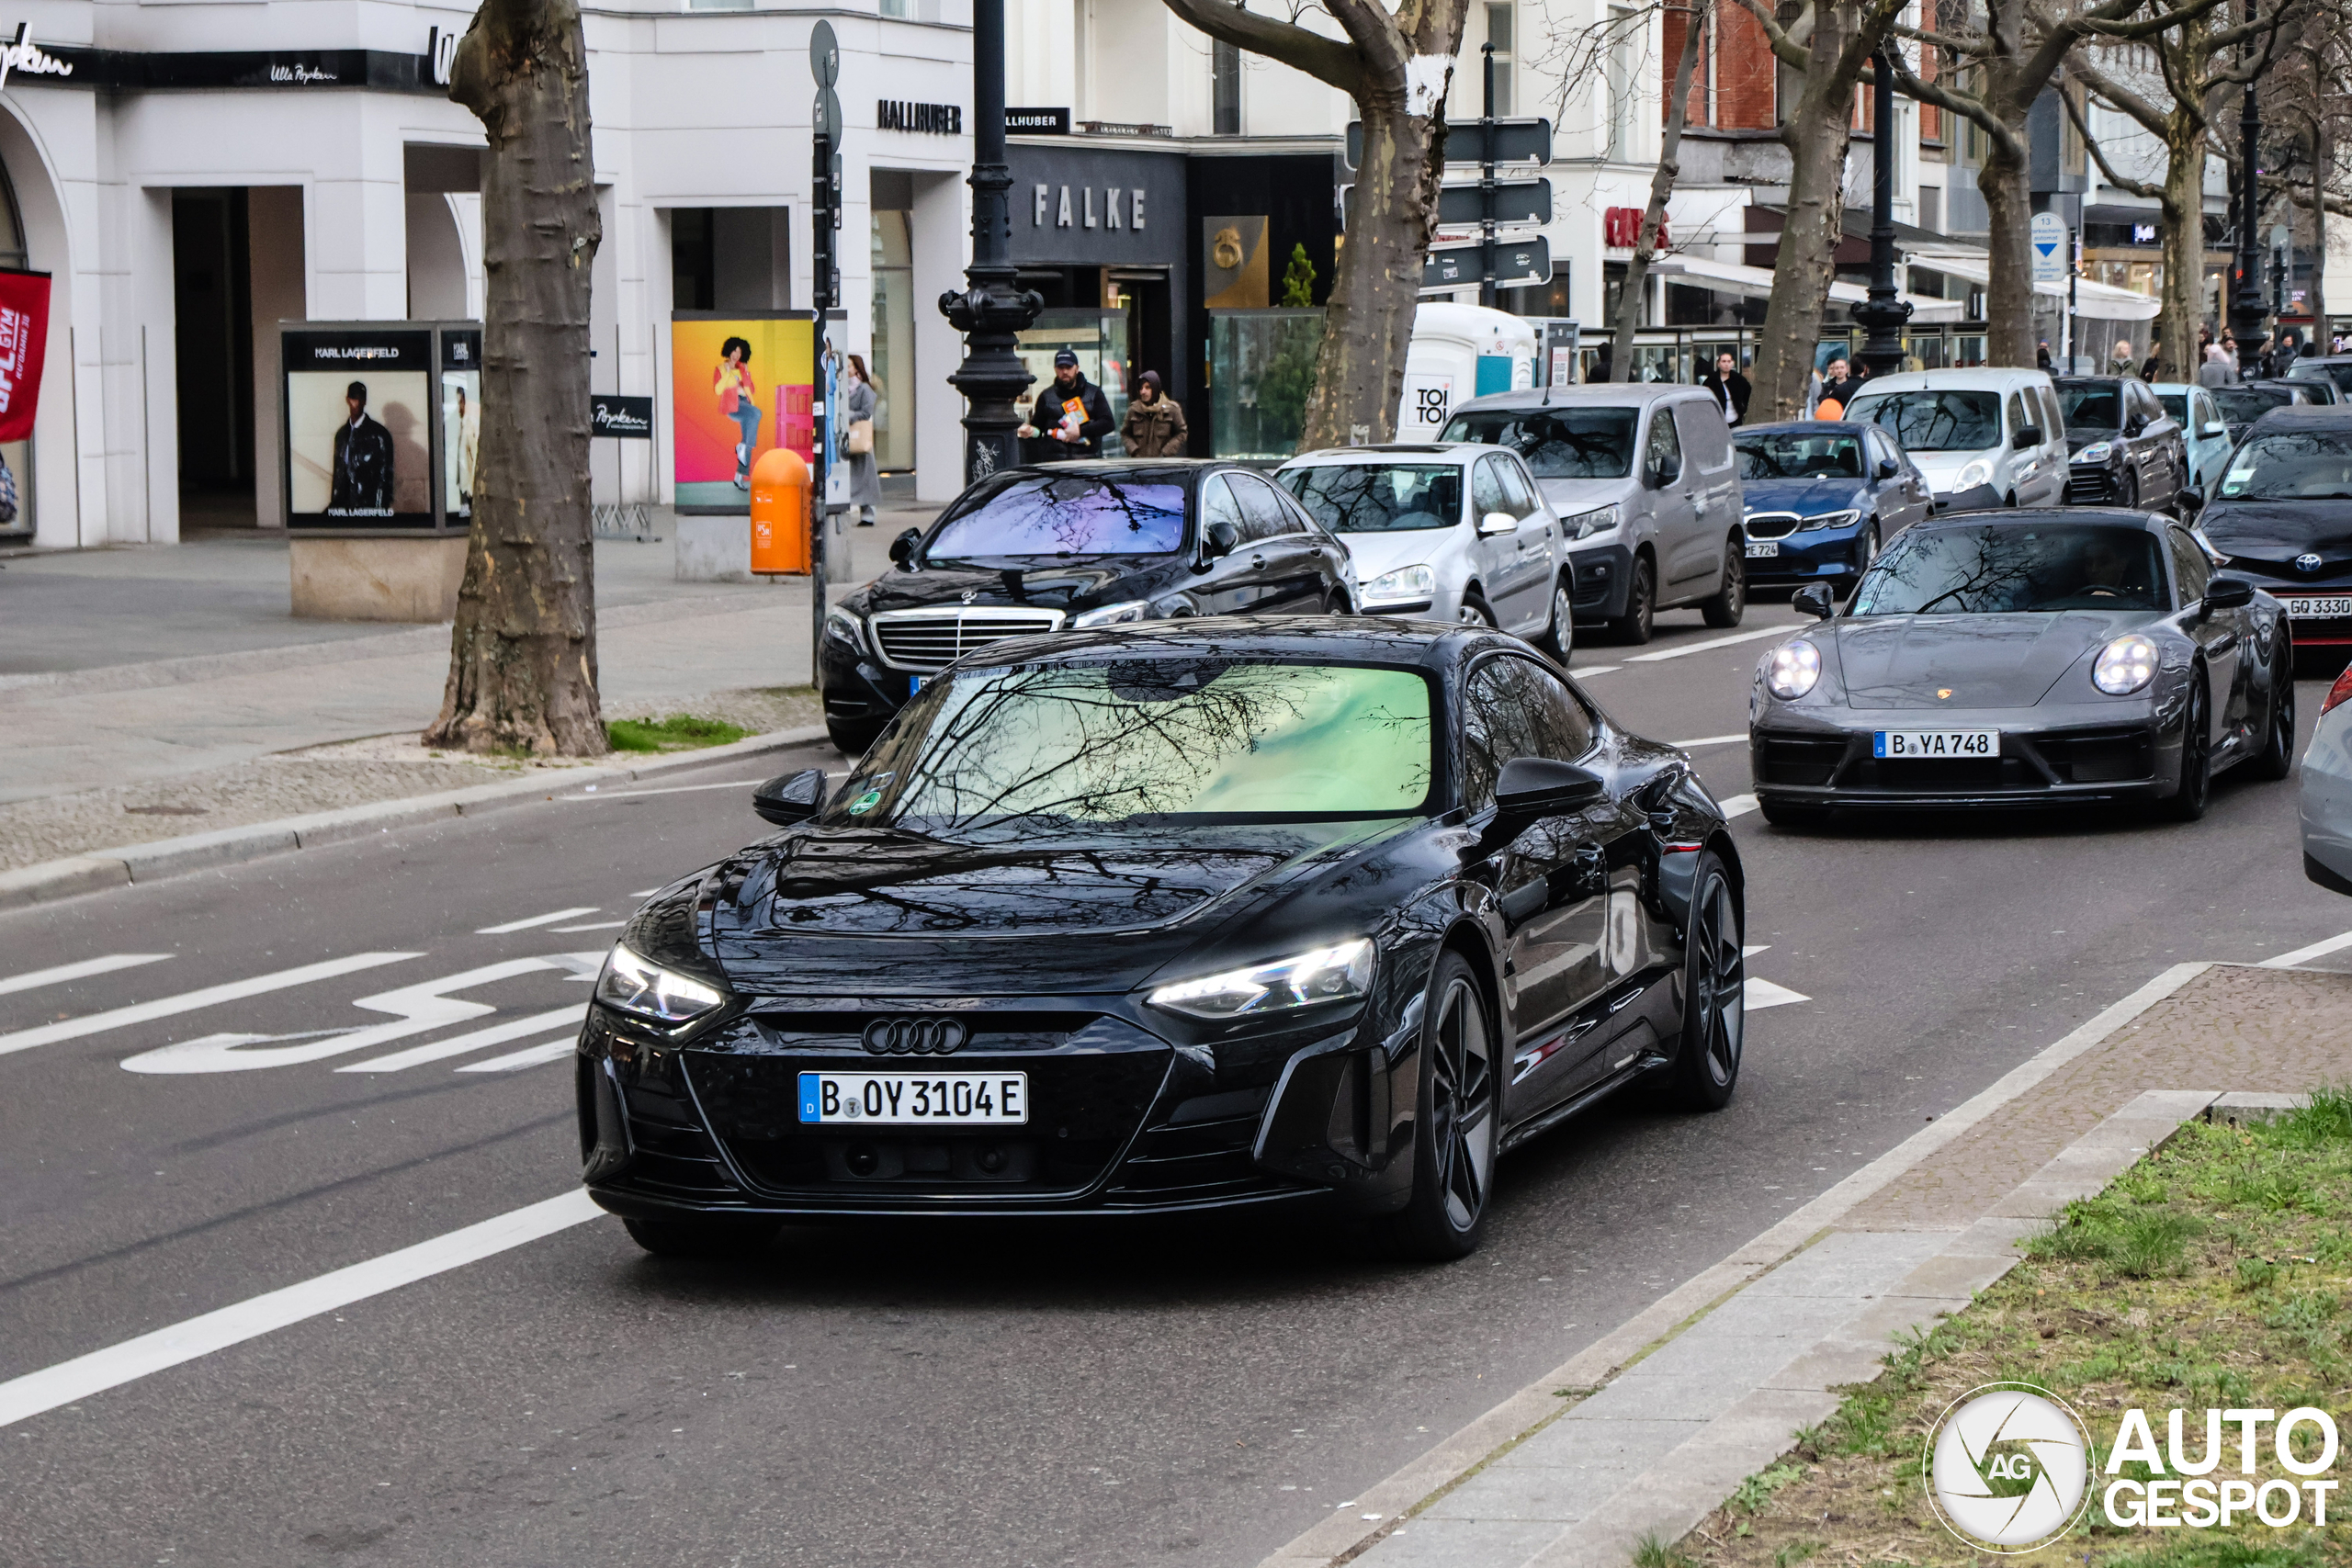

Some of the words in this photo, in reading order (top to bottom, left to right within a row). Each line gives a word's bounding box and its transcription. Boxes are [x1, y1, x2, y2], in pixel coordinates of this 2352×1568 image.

[271, 65, 293, 82] Ulla
[294, 63, 337, 85] Popken
[877, 99, 962, 135] HALLHUBER
[1005, 116, 1057, 126] LLHUBER
[1035, 184, 1145, 230] FALKE
[315, 347, 341, 358] KARL
[342, 347, 399, 359] LAGERFELD
[1417, 389, 1448, 406] TOI
[596, 403, 648, 429] Popken
[1416, 406, 1447, 423] TOI
[328, 507, 348, 516] KARL
[348, 507, 394, 517] LAGERFELD
[1758, 546, 1776, 556] 724
[2290, 600, 2310, 614] GQ
[2313, 600, 2350, 614] 3330
[1893, 735, 1905, 754] B
[1919, 735, 1945, 754] YA
[1951, 734, 1989, 754] 748
[821, 1080, 840, 1116] B
[806, 1103, 814, 1114] D
